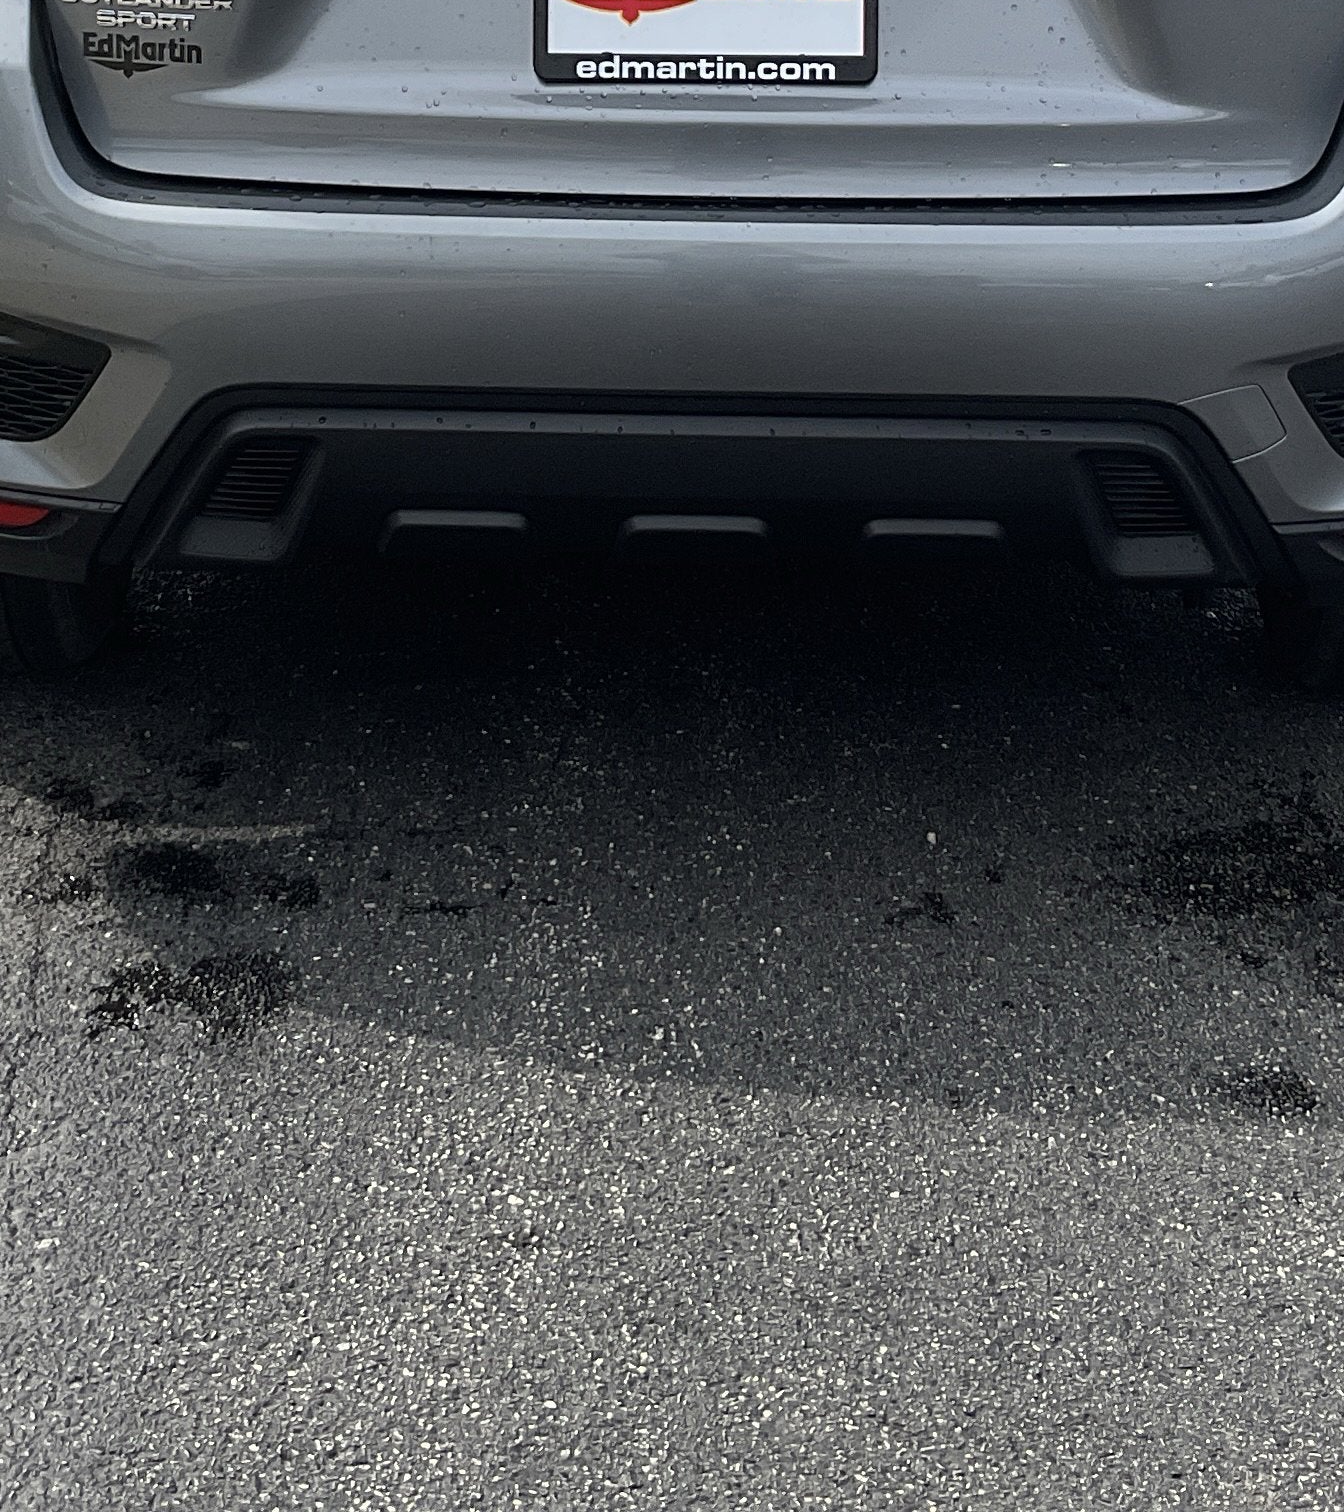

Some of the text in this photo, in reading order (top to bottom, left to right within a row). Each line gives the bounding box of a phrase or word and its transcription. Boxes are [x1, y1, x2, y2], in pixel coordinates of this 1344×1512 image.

[96, 9, 196, 32] SPORT
[82, 32, 203, 65] EdMartin
[576, 55, 837, 81] edmartin.com
